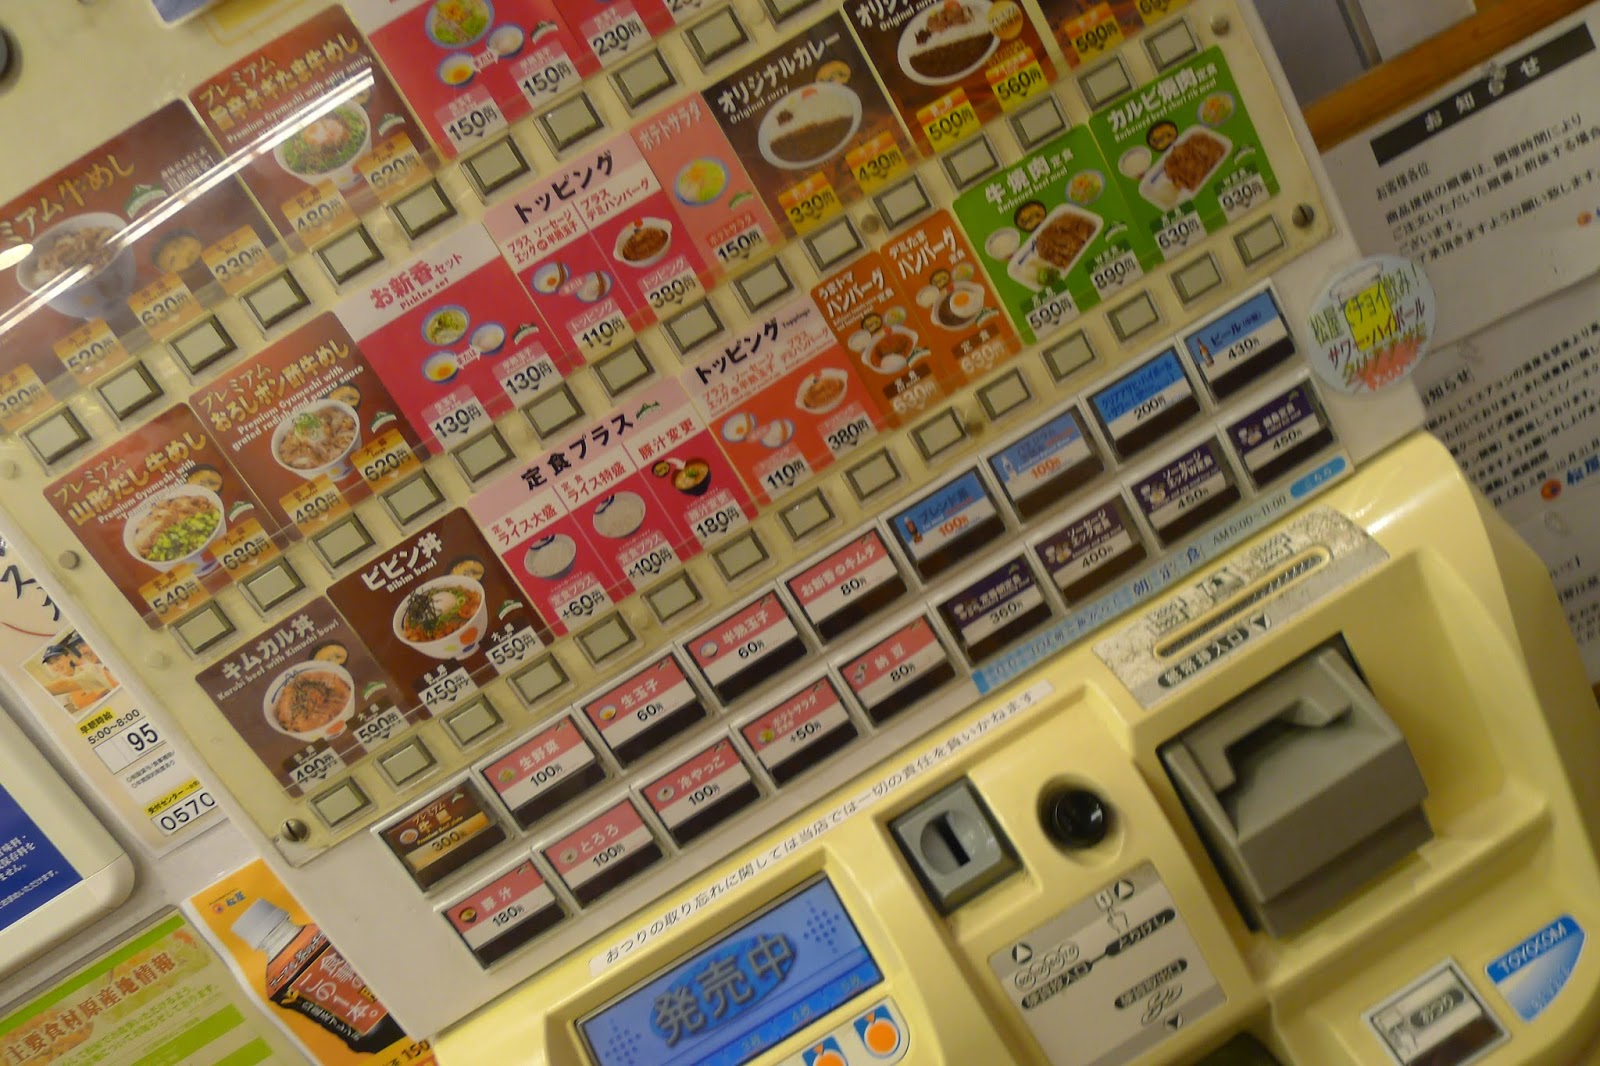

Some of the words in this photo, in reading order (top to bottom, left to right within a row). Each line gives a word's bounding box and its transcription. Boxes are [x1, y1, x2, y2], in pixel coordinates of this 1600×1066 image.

[199, 53, 276, 110] プレミアム
[716, 30, 842, 115] オリジナルカレー
[227, 116, 265, 144] Premium
[638, 99, 704, 152] ポテトサラダ
[729, 96, 766, 126] Original
[515, 150, 618, 224] トッピング
[581, 187, 609, 211] プラス
[587, 178, 652, 222] デミハンバーグ
[507, 233, 531, 254] プラス
[534, 209, 573, 238] ソーセージ
[717, 227, 762, 263] 150円
[888, 229, 928, 259] デミたま
[897, 225, 962, 279] ハンバーグ
[400, 285, 433, 310] Pickles
[650, 273, 696, 309] 380円
[824, 267, 889, 317] ハンバーグ
[571, 299, 615, 331] トッピング
[582, 314, 625, 350] 110円
[1210, 321, 1243, 346] ビール
[696, 318, 783, 385] トッピング
[199, 360, 272, 414] プレミアム
[210, 335, 351, 434] おろしポン酢牛めし
[505, 358, 552, 396] 130円
[232, 427, 262, 451] grated
[339, 364, 365, 383] sauce
[237, 404, 279, 434] Premium
[278, 377, 323, 411] Gyumeshi
[322, 363, 344, 382] with
[434, 401, 482, 439] 130円
[638, 418, 696, 460] 豚汁変更
[521, 412, 634, 491] 定食プラス
[55, 451, 127, 505] プレミアム
[66, 425, 209, 527] 山形だし牛めし
[97, 496, 136, 524] Premium
[176, 457, 196, 475] with
[567, 460, 627, 504] ライス特盛
[497, 504, 558, 546] ライス大盛
[695, 504, 740, 539] 180円
[362, 530, 445, 593] ビビン丼
[386, 572, 413, 593] Bibim
[413, 557, 439, 576] bowl
[840, 573, 867, 596] 80円
[721, 608, 771, 646] 半熟玉子
[217, 677, 247, 701] Karubi
[245, 665, 266, 683] beef
[264, 653, 285, 671] with
[285, 633, 318, 659] Kimuchi
[318, 619, 339, 638] bowl
[222, 612, 315, 681] キムカル丼
[737, 637, 765, 660] 60円
[889, 660, 916, 682] 80円
[619, 677, 660, 709] 生玉子
[637, 699, 665, 721] 60円
[127, 721, 159, 754] 95
[519, 738, 561, 770] 生野菜
[529, 761, 563, 788] 100円
[678, 754, 725, 790] 冷やっこ
[687, 782, 720, 806] 100円
[579, 821, 620, 854] とろろ
[591, 840, 626, 867] 100円
[650, 927, 799, 1047] 発売中
[6, 952, 176, 1065] 主要食材原産地情報
